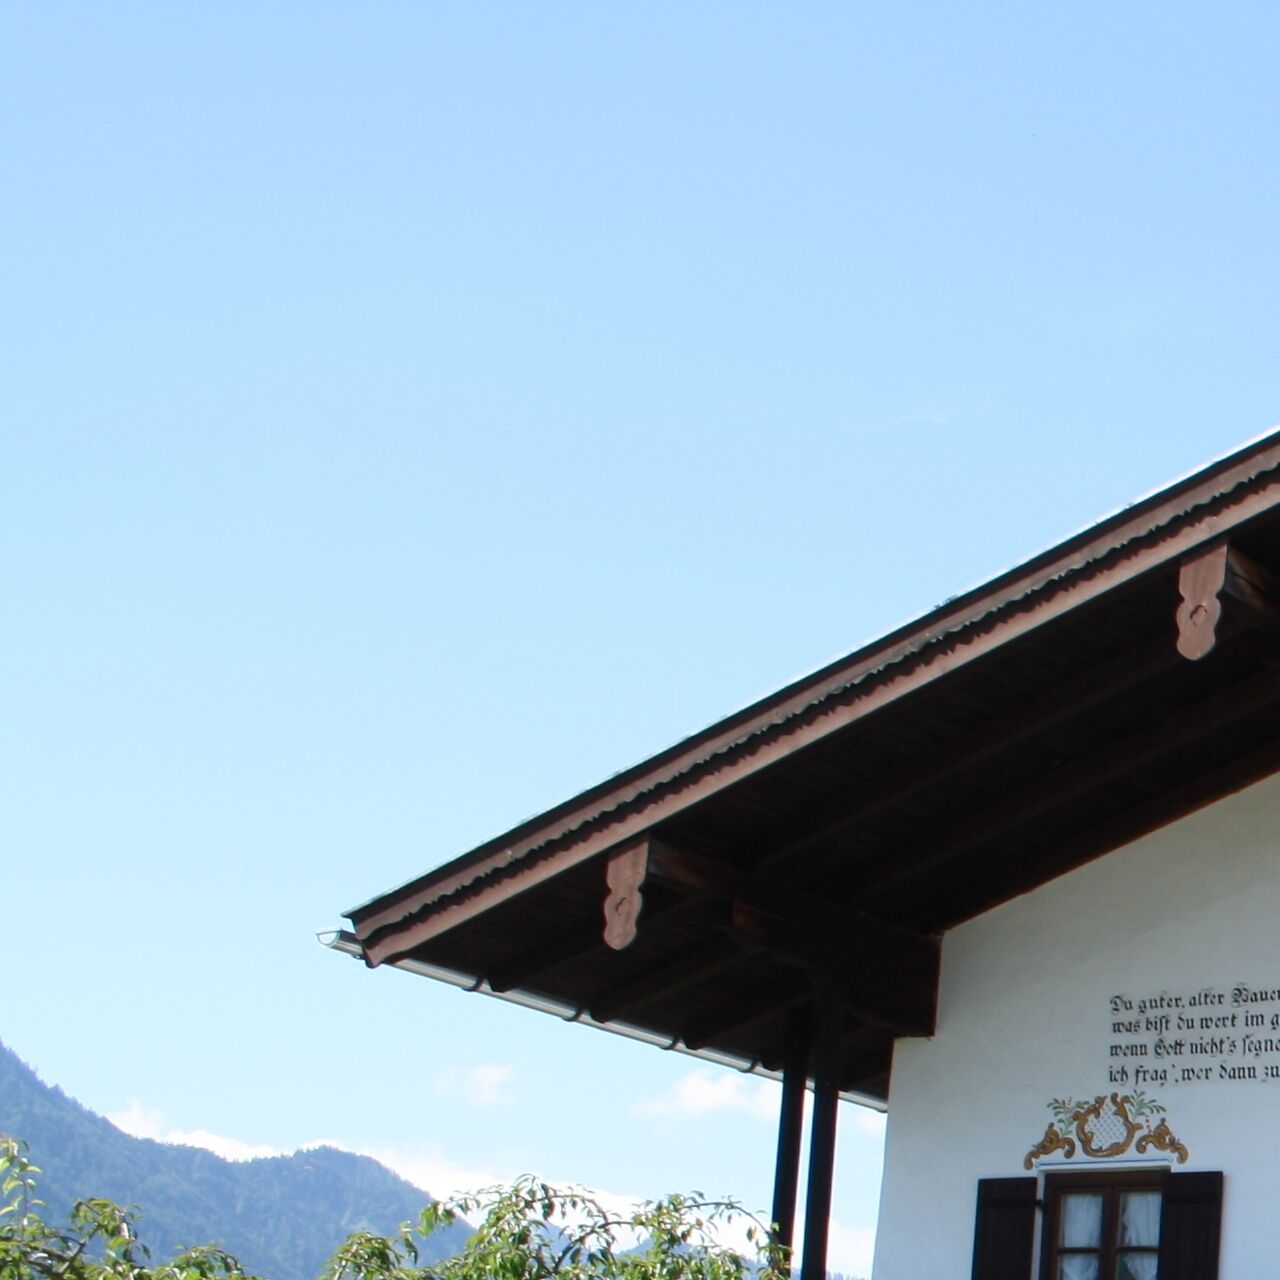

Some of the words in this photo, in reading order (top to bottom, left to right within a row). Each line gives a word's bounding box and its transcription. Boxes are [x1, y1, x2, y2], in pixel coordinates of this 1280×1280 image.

[1110, 994, 1133, 1014] Du
[1189, 988, 1225, 1007] alter
[1112, 1020, 1140, 1034] was
[1177, 1013, 1195, 1030] du
[1200, 1013, 1237, 1029] wert
[1245, 1010, 1264, 1027] im
[1110, 1044, 1147, 1057] wenn
[1154, 1037, 1185, 1059] Gott
[1109, 1064, 1129, 1085] ich
[1182, 1067, 1213, 1080] wer
[1219, 1061, 1257, 1080] dann
[1264, 1065, 1280, 1082] zu
